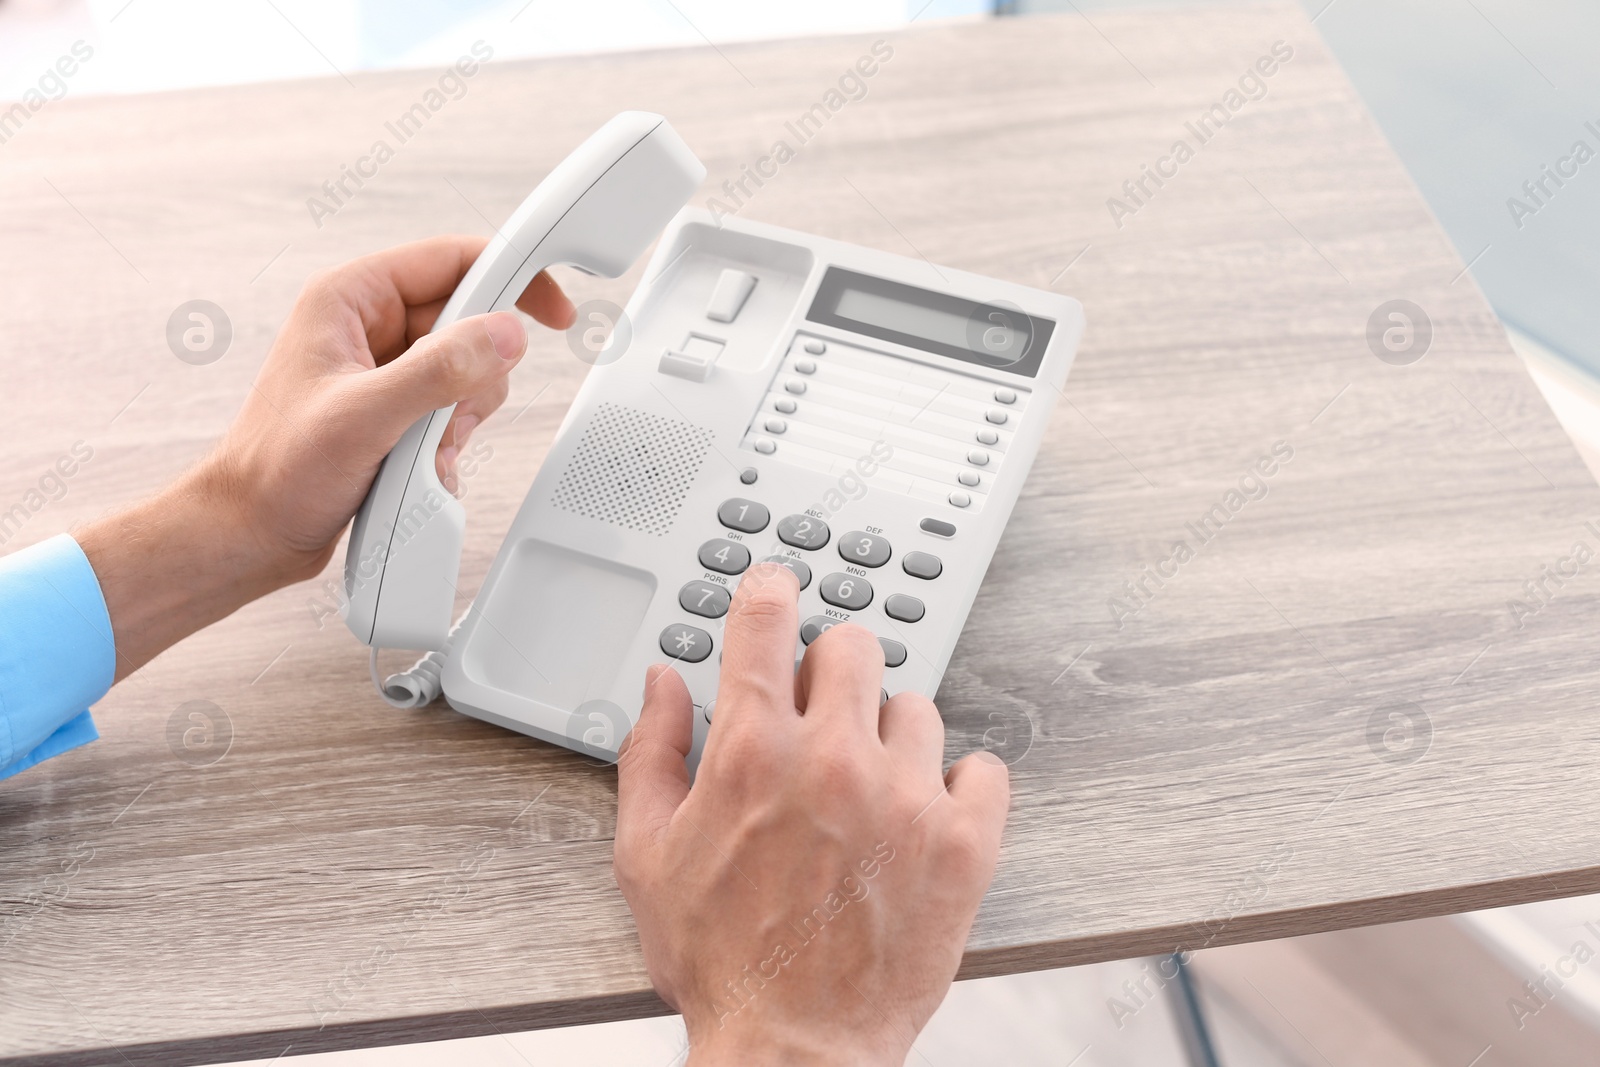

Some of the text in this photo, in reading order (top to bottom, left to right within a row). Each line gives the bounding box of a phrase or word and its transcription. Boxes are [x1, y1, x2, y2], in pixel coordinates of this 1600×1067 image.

[739, 505, 749, 522] 1
[804, 509, 823, 519] ABC
[793, 521, 812, 539] 2
[865, 525, 884, 535] DEF
[727, 532, 743, 542] GHI
[855, 538, 872, 556] 3
[714, 546, 730, 564] 4
[786, 550, 802, 559] JKL
[846, 566, 867, 577] MNO
[704, 573, 728, 585] PQRS
[838, 580, 854, 599] 6
[697, 588, 715, 607] 7
[825, 608, 851, 621] WXYZ
